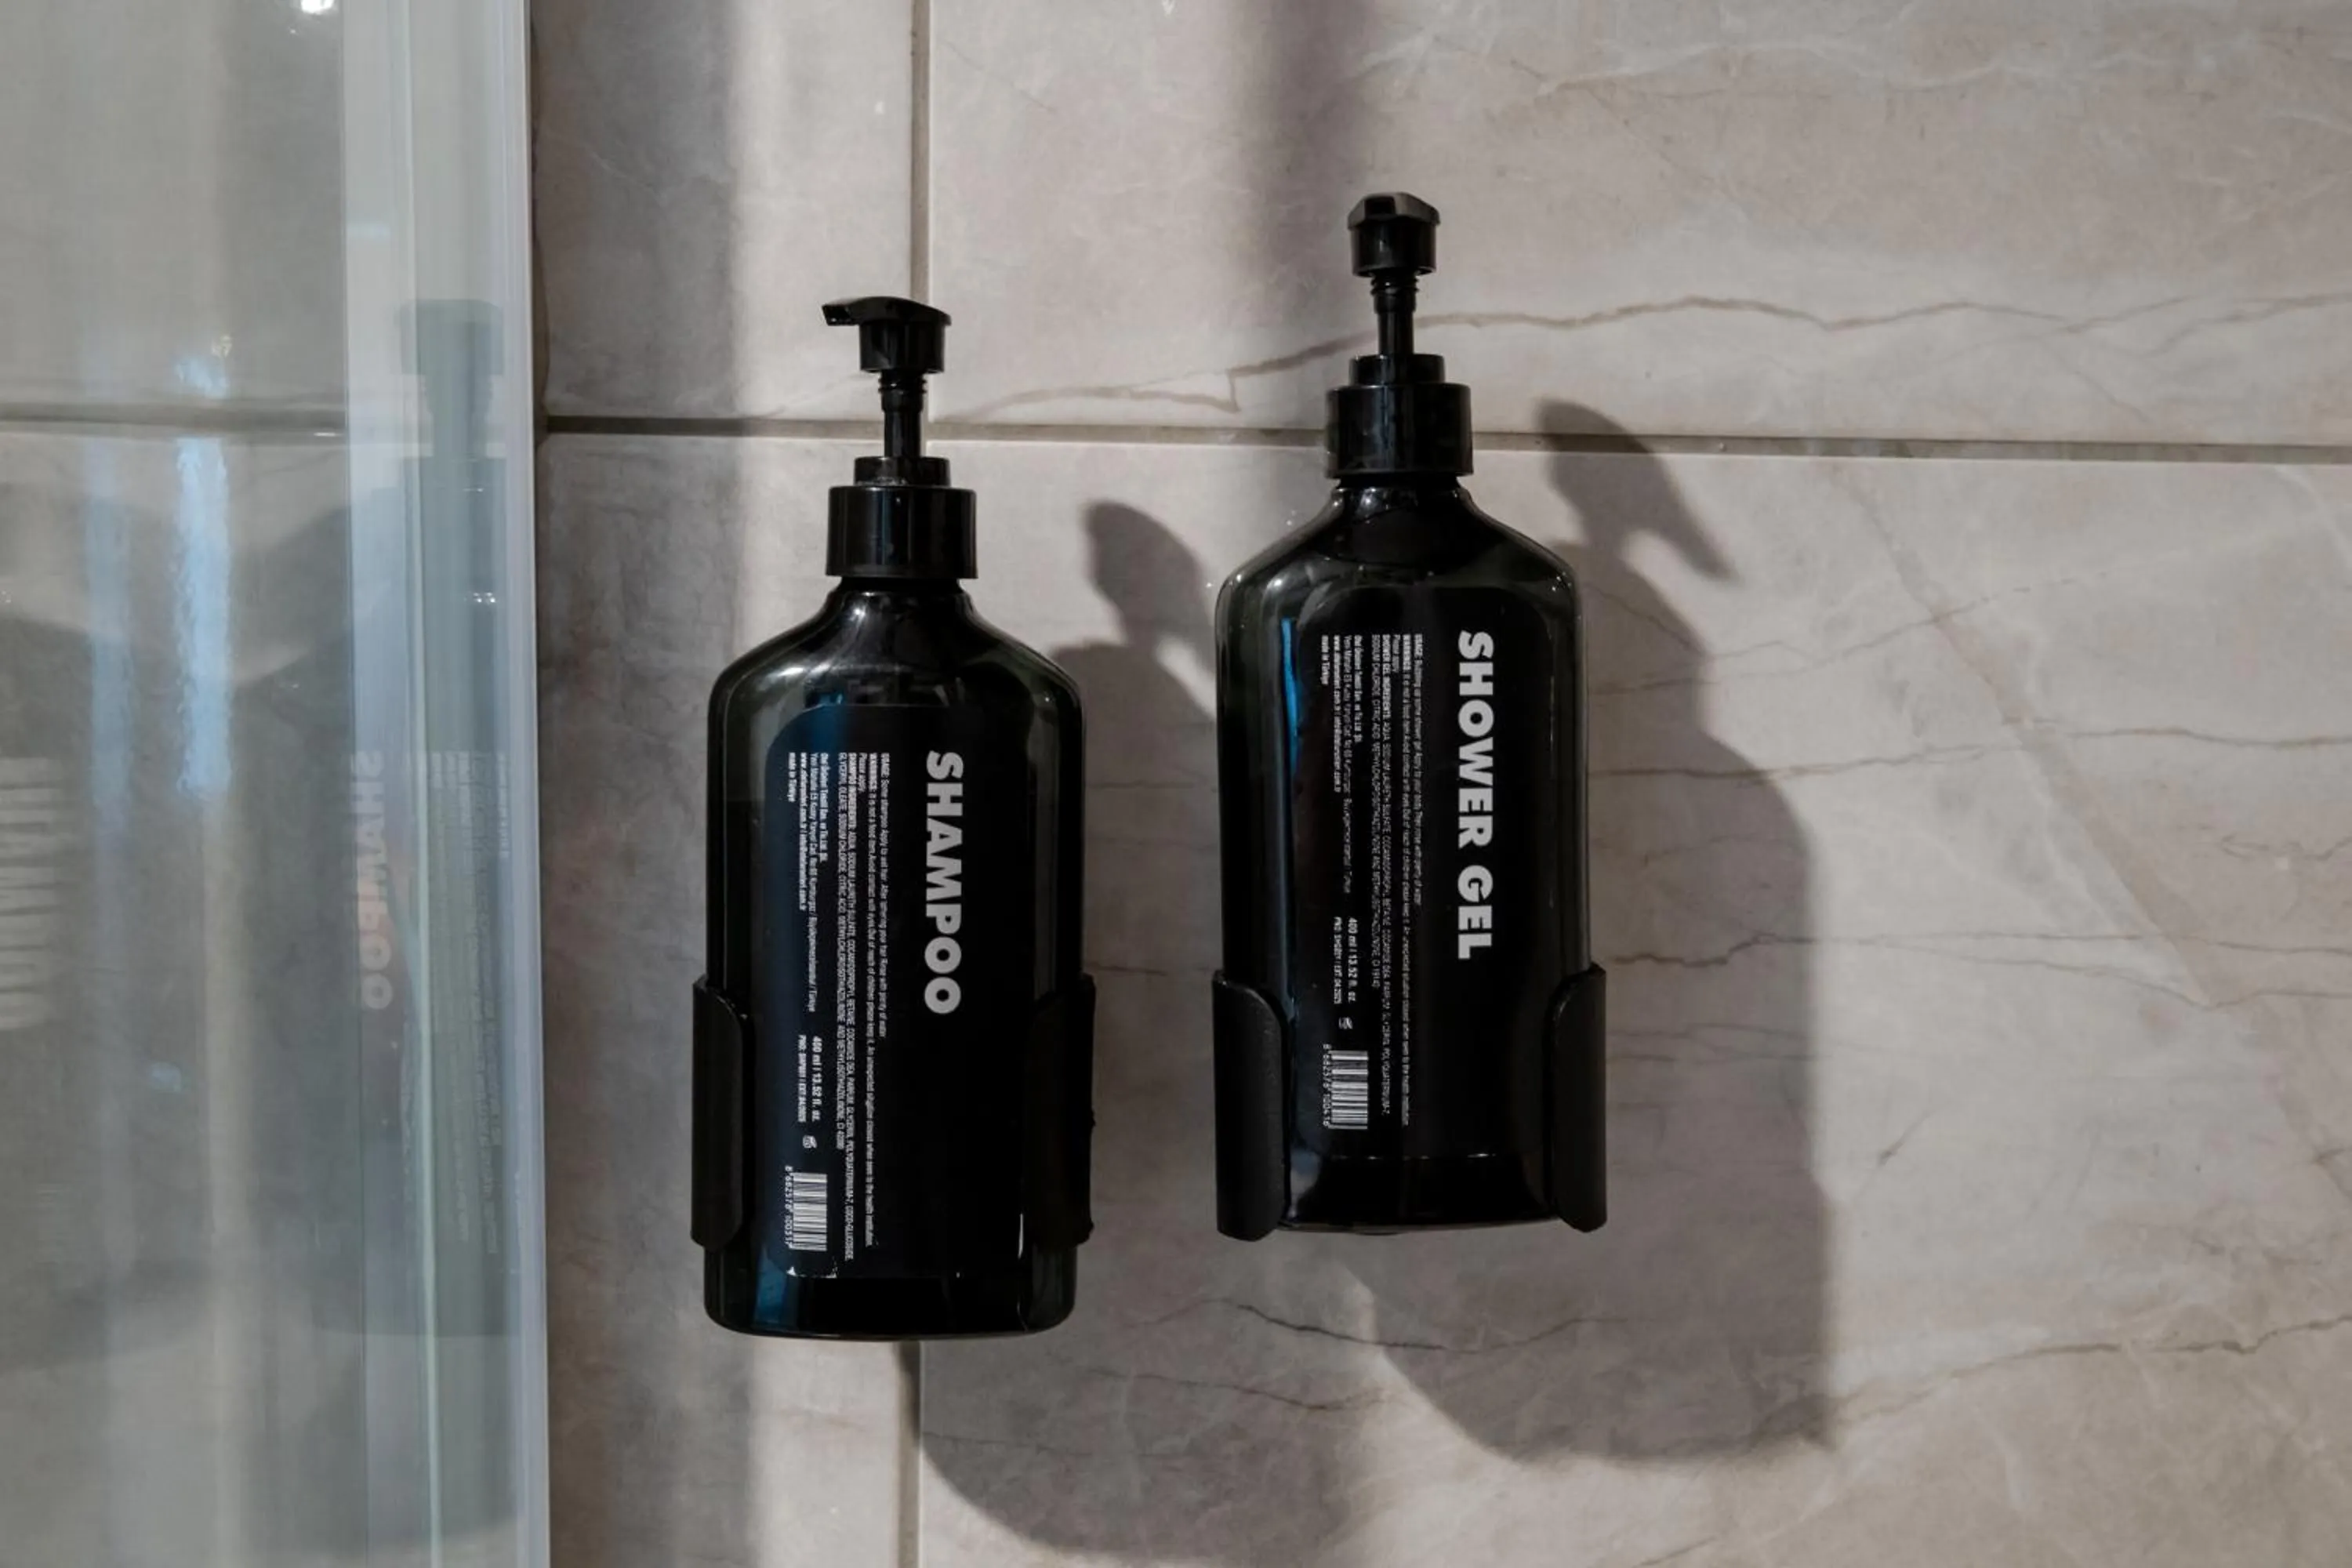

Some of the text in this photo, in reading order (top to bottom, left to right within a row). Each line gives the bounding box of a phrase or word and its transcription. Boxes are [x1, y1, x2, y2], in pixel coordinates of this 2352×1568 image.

[924, 750, 964, 1014] SHAMPOO
[1348, 918, 1357, 934] 400
[1457, 630, 1494, 960] SHOWER GEL
